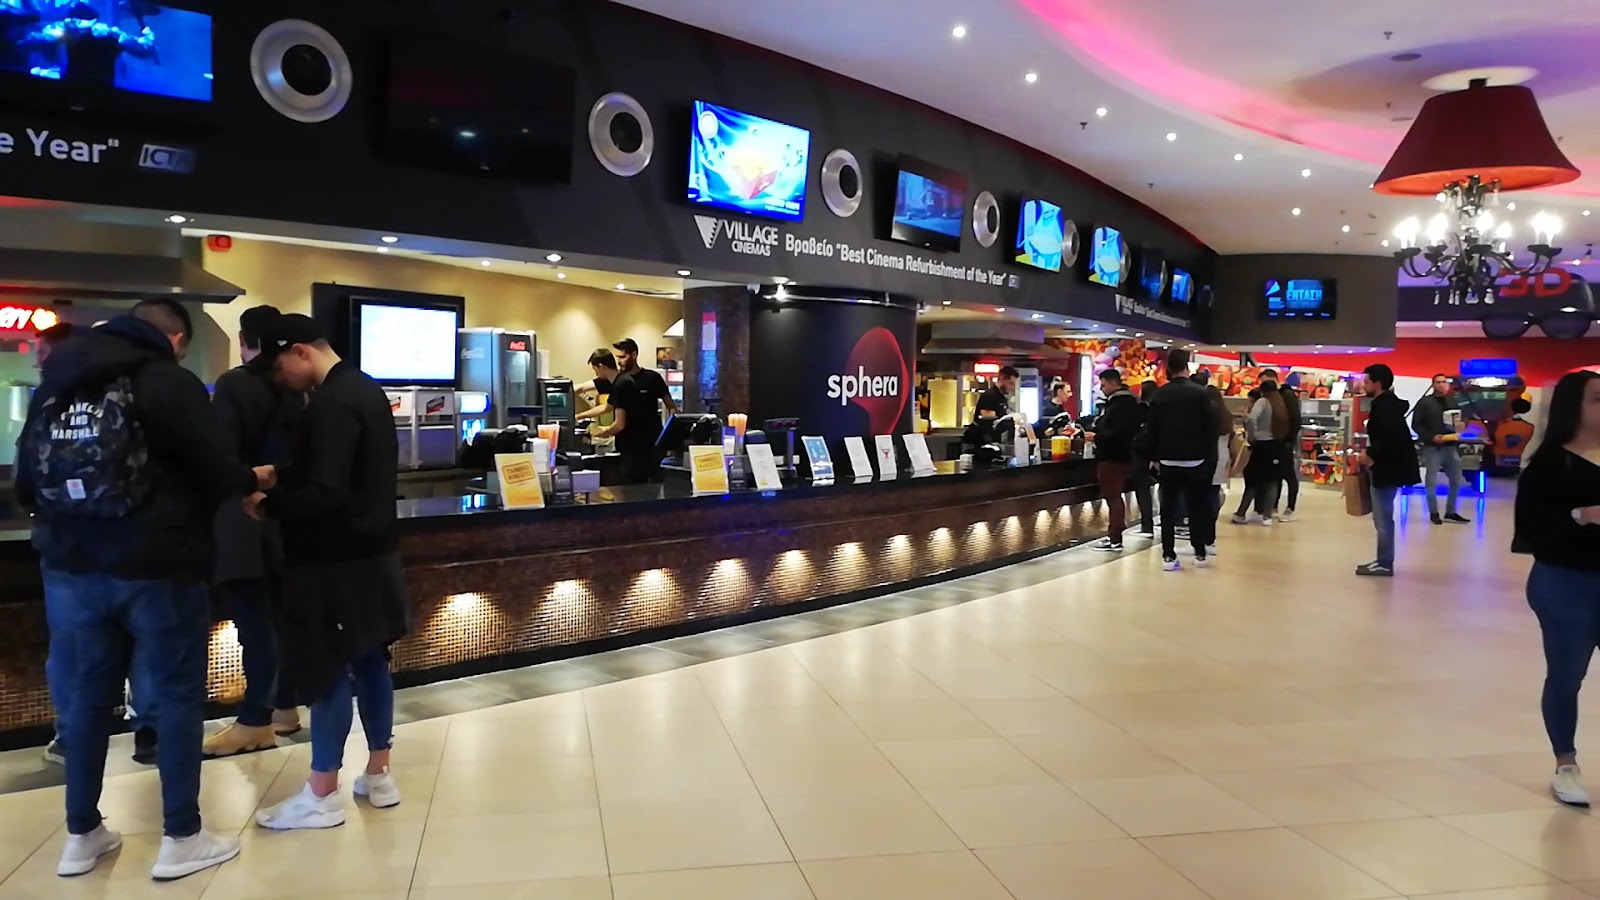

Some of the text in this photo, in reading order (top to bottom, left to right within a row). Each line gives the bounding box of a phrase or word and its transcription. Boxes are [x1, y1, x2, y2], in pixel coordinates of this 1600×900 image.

[26, 127, 120, 164] Year"
[724, 219, 779, 246] VILLAGE
[731, 240, 771, 257] CINEMAS
[785, 232, 834, 257] Βραβείο
[866, 248, 904, 270] Cinema
[905, 254, 966, 281] Refurbishment
[966, 266, 976, 282] of
[1500, 266, 1572, 297] 3D
[826, 365, 899, 406] sphera
[69, 414, 89, 426] AND
